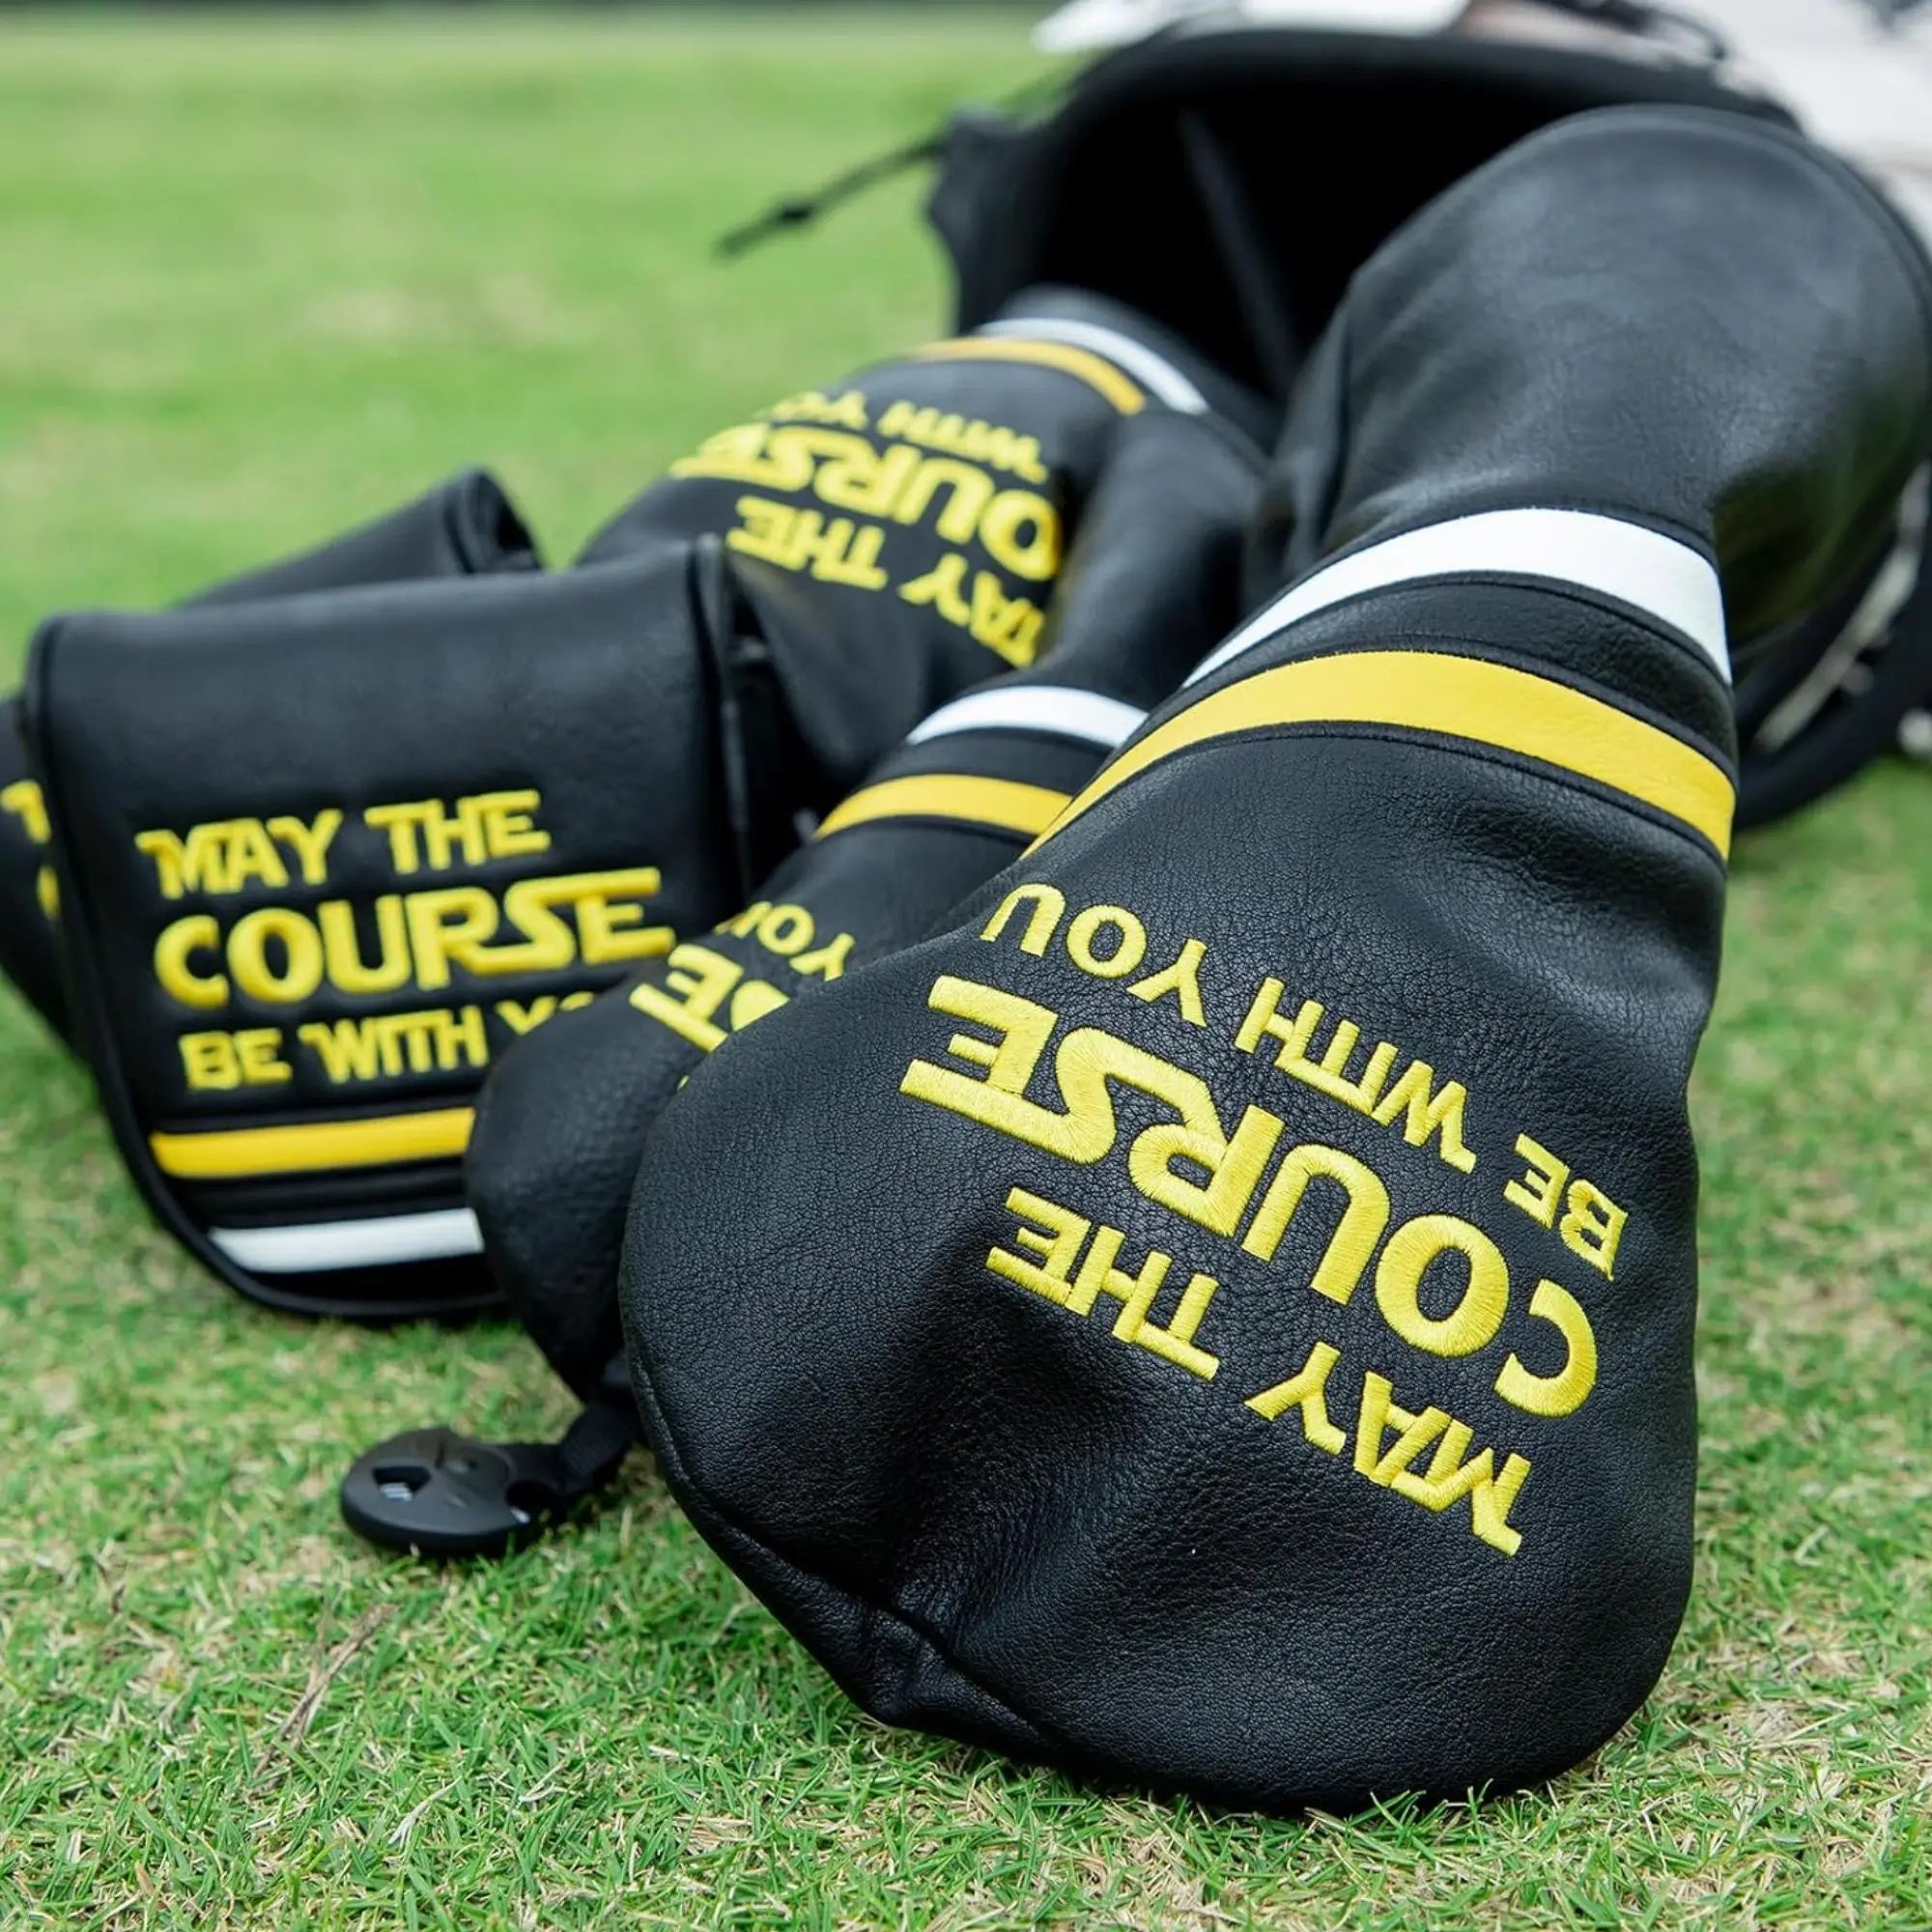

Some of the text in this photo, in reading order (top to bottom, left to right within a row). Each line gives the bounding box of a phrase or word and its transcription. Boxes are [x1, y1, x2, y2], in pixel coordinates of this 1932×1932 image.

[725, 495, 889, 590] THE
[134, 810, 342, 899] MAY
[365, 789, 550, 874] THE
[153, 867, 674, 1009] COURSE
[179, 1027, 292, 1091] BE
[298, 1005, 489, 1085] WITH
[980, 883, 1629, 1282] BE WITH YOU
[899, 974, 1598, 1419] COURSE
[985, 1186, 1531, 1556] MAY THE
